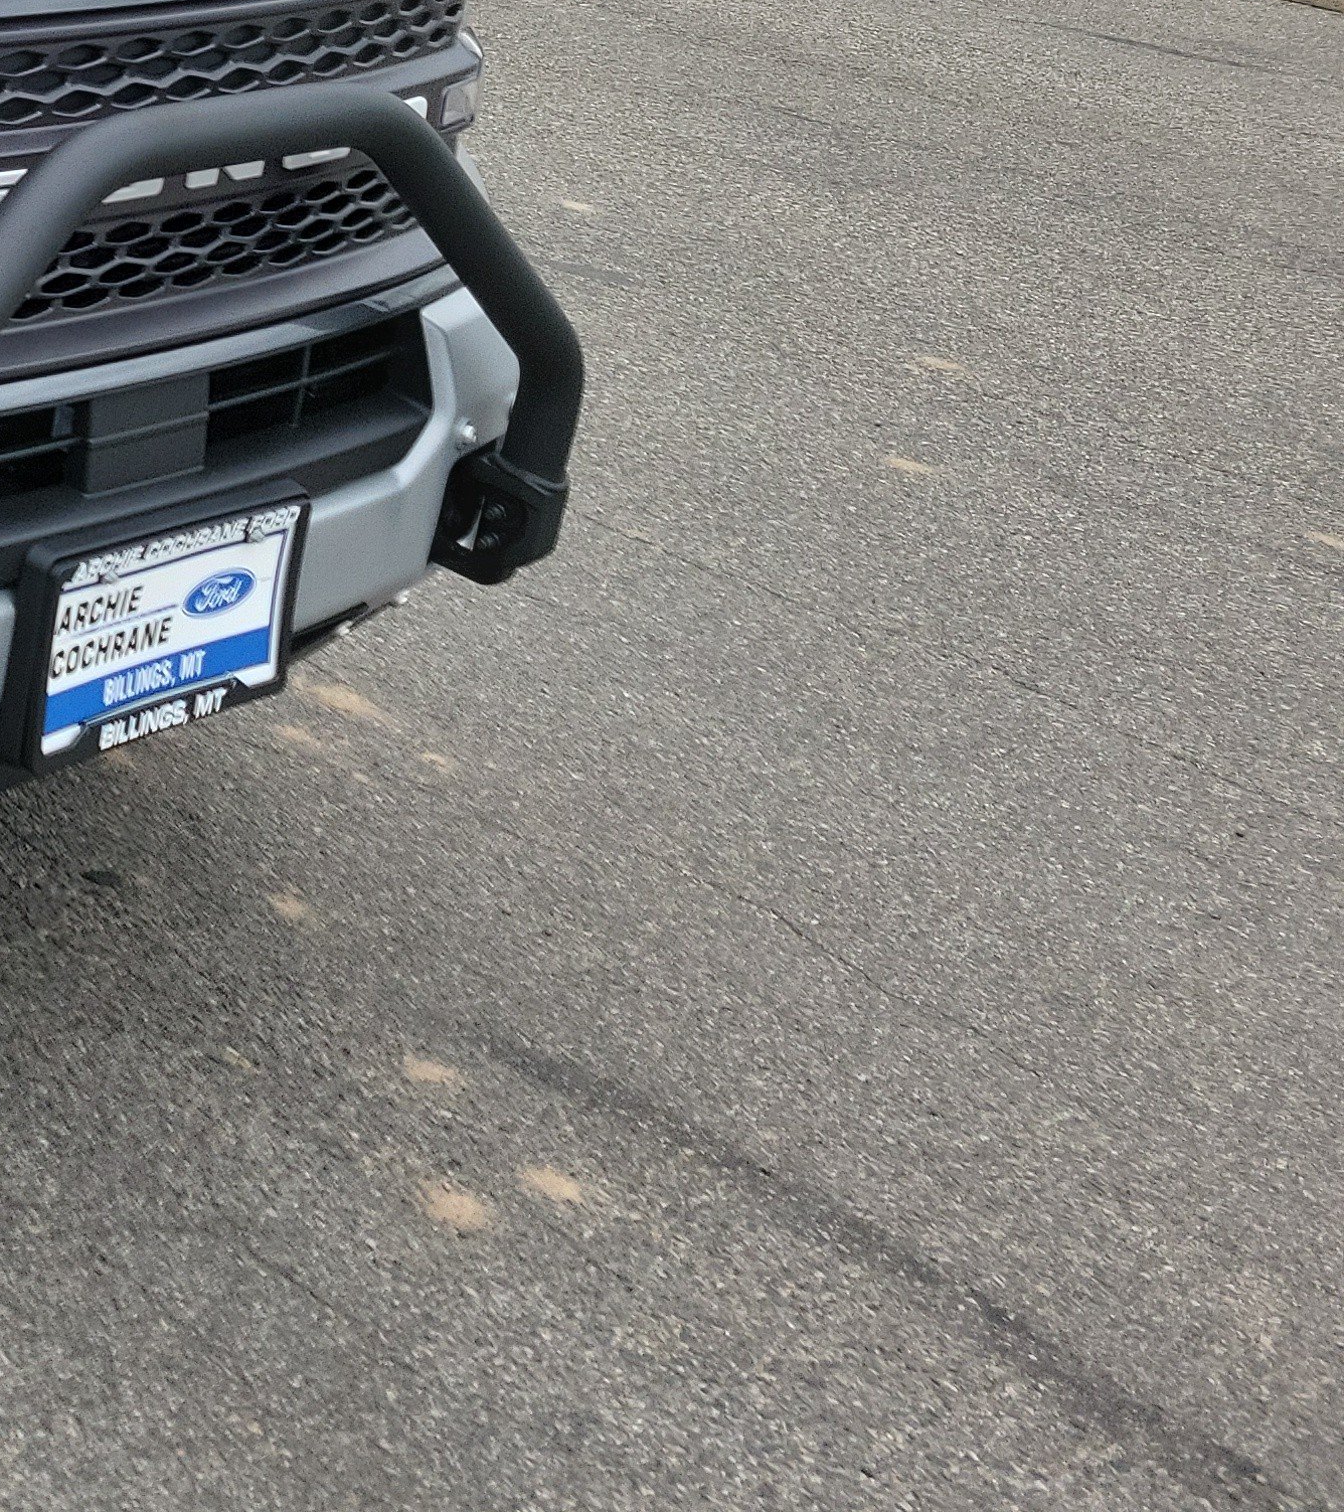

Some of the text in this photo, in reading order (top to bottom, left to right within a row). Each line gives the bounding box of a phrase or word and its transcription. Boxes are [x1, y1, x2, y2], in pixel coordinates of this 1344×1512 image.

[71, 545, 145, 584] ARCHIE
[249, 505, 302, 537] FORD
[54, 585, 144, 637] ARCHIE
[194, 576, 242, 612] Ford
[50, 616, 173, 680] COCHRANE
[103, 649, 206, 707] BILLINGS, MT
[98, 687, 228, 751] BILLINGS, MT
